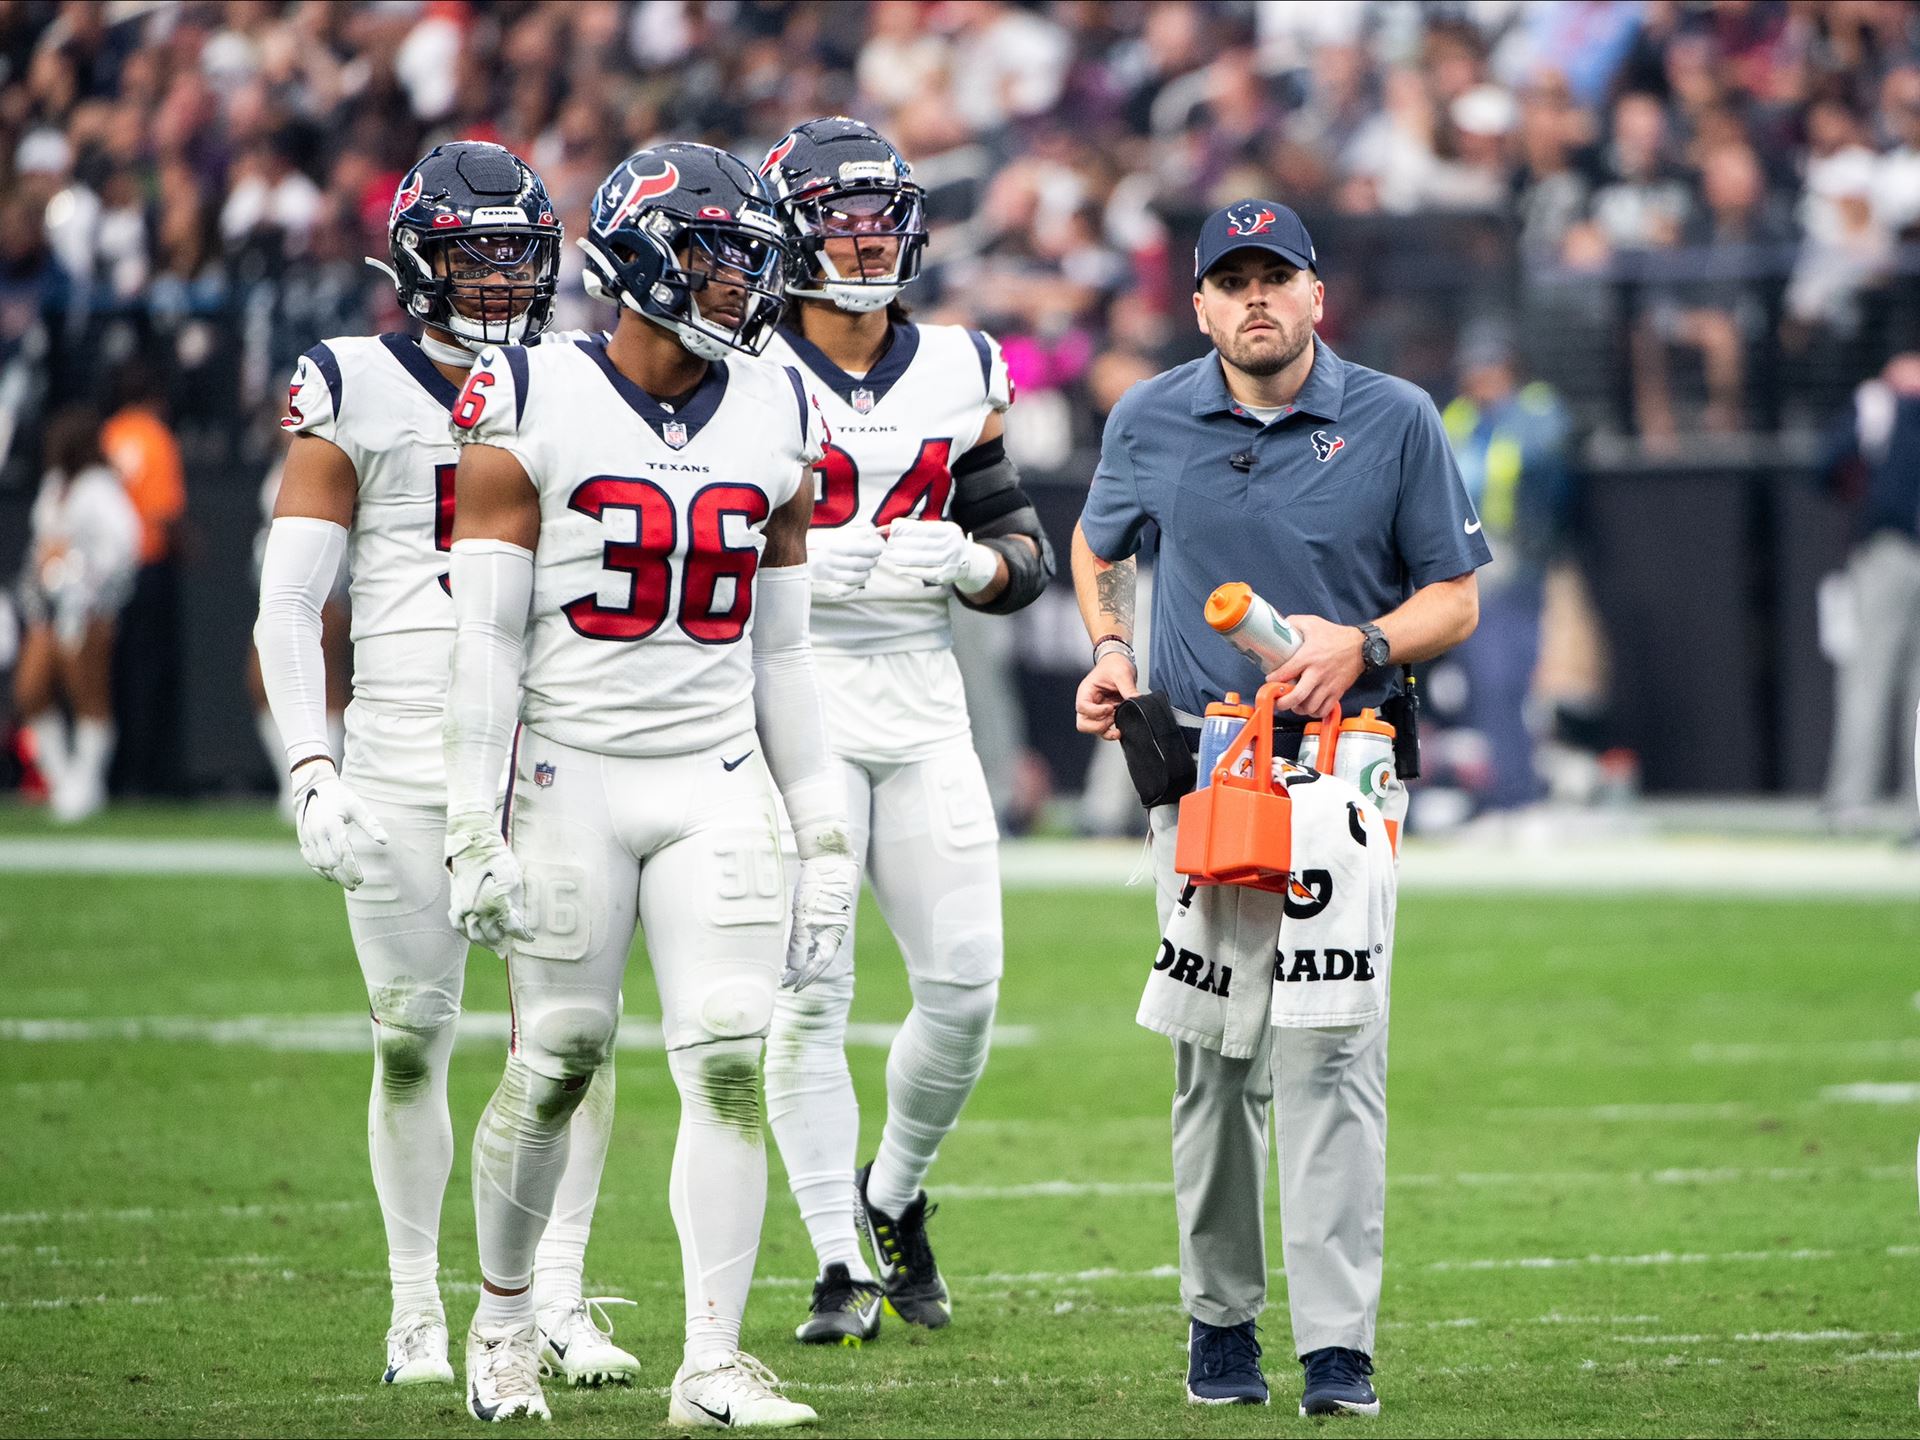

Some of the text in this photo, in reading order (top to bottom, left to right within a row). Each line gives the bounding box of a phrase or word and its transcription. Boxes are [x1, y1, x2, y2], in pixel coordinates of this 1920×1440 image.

[452, 371, 496, 430] 6
[837, 425, 898, 433] TEXANS
[645, 462, 710, 473] TEXANS
[560, 475, 771, 646] 36
